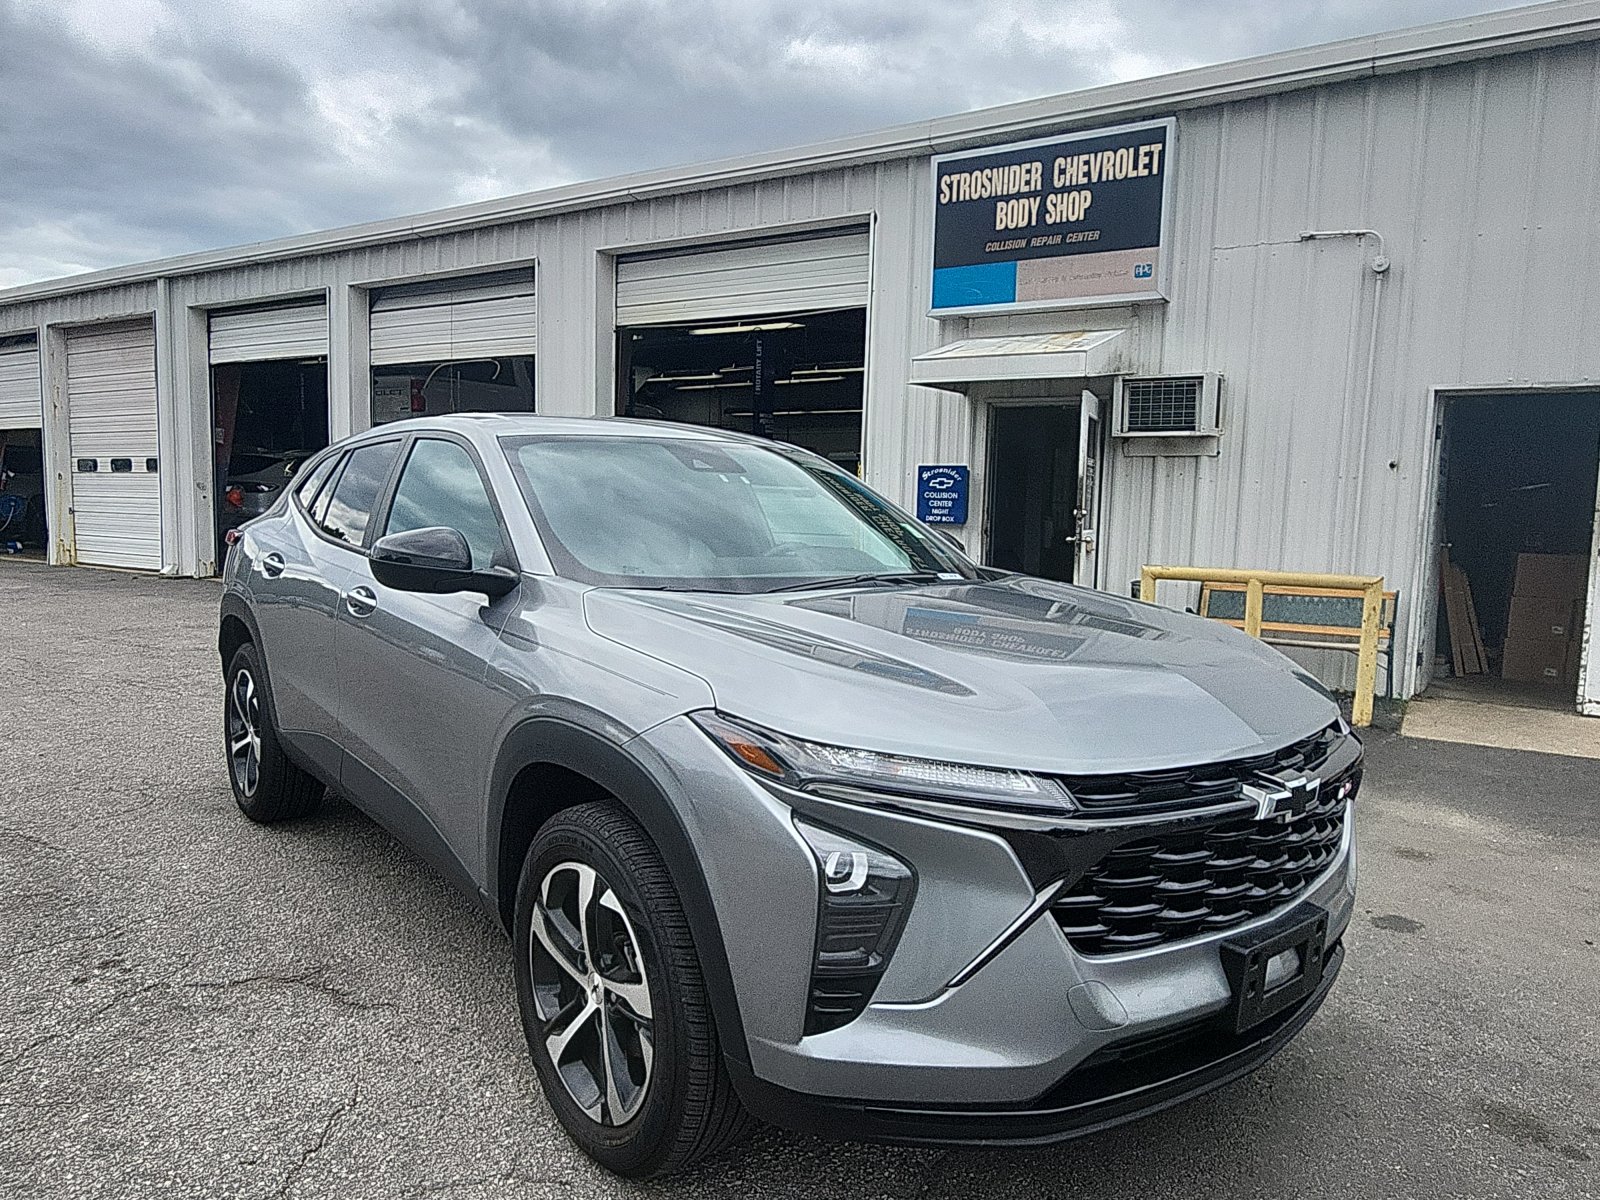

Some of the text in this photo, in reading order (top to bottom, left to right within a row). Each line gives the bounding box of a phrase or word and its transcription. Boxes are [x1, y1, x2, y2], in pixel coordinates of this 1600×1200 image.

[940, 143, 1163, 204] STROSNIDER CHEVROLET
[995, 190, 1093, 230] BODY SHOP
[985, 230, 1101, 252] COLLISION REPAIR CENTER
[1135, 264, 1152, 277] PPG
[922, 468, 962, 480] Strosnider
[924, 491, 958, 499] COLLISION
